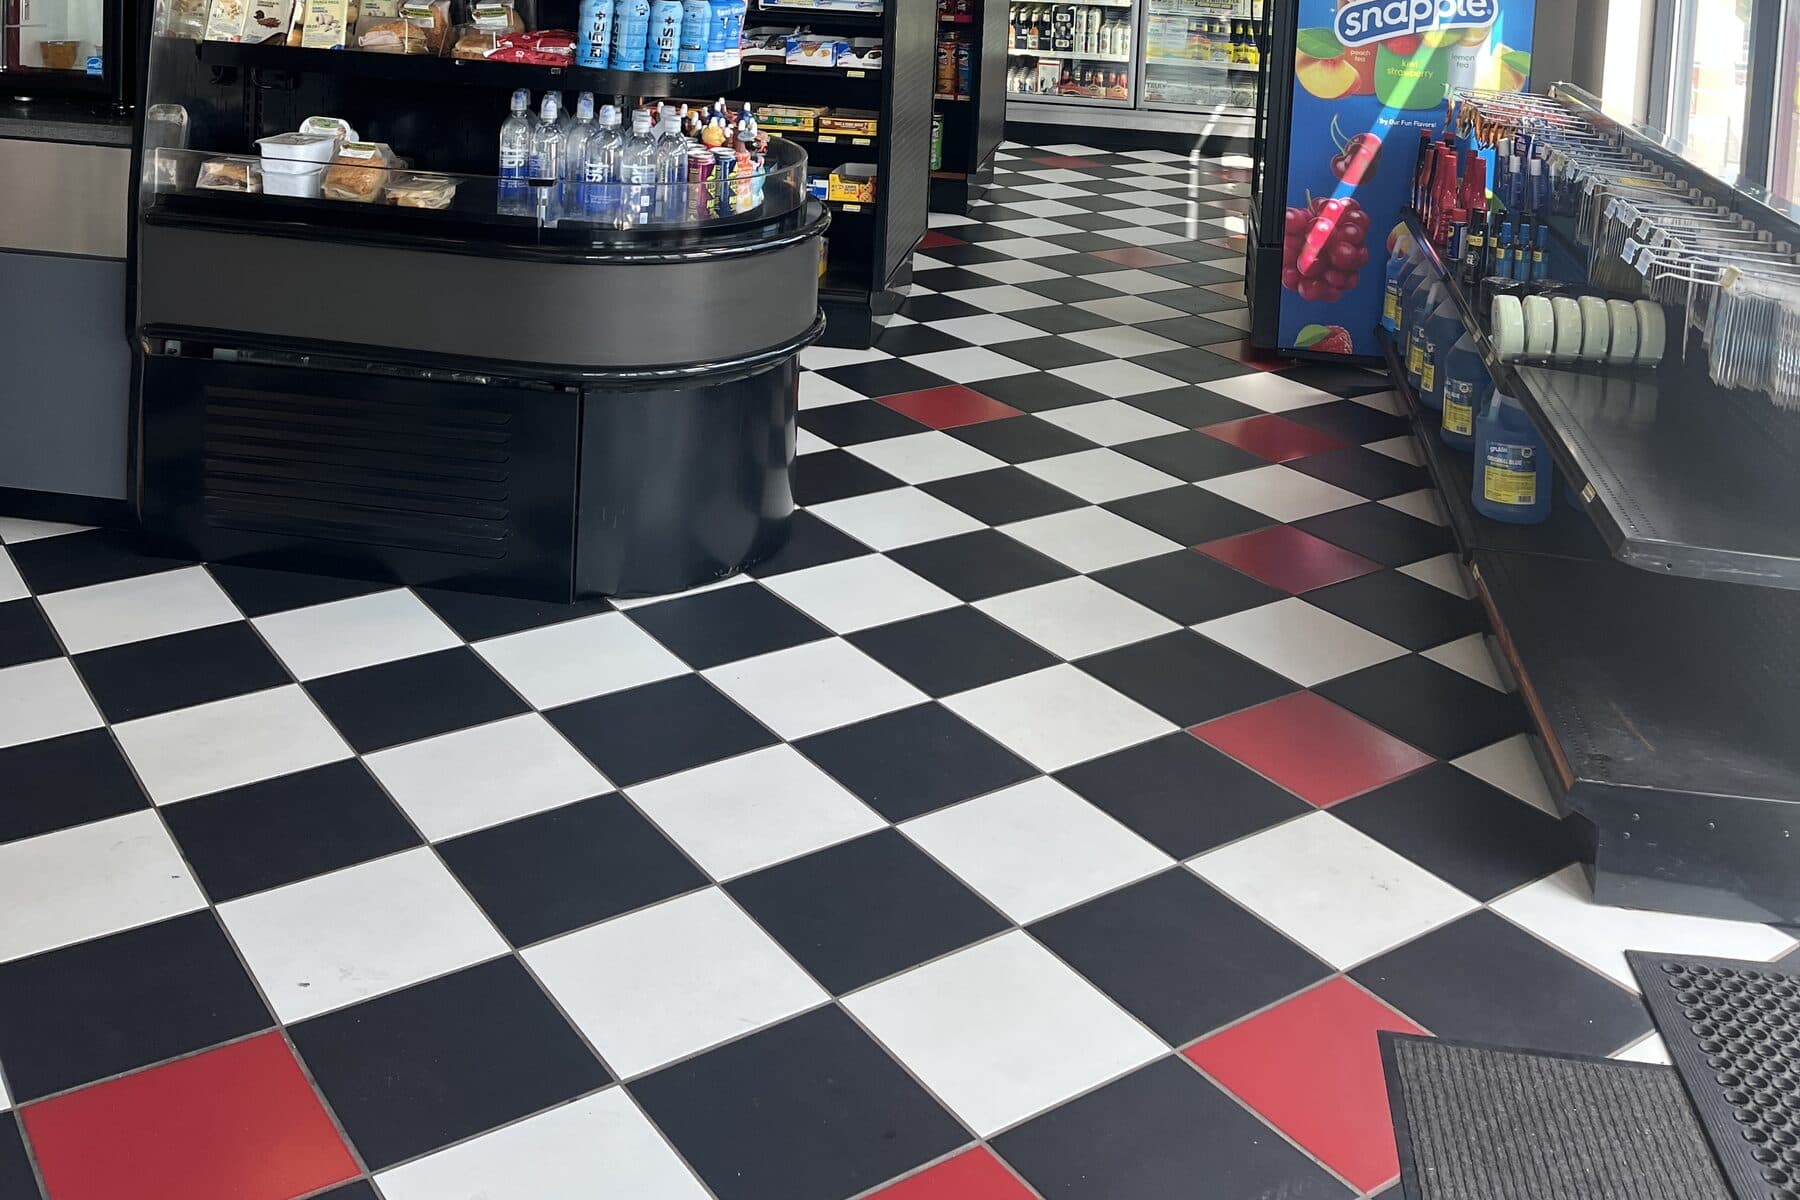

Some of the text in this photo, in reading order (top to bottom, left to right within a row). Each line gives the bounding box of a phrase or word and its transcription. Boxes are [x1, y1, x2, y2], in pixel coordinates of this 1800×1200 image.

[1456, 61, 1469, 69] tea
[1387, 67, 1434, 78] strawberry
[1413, 120, 1437, 128] Flavors!
